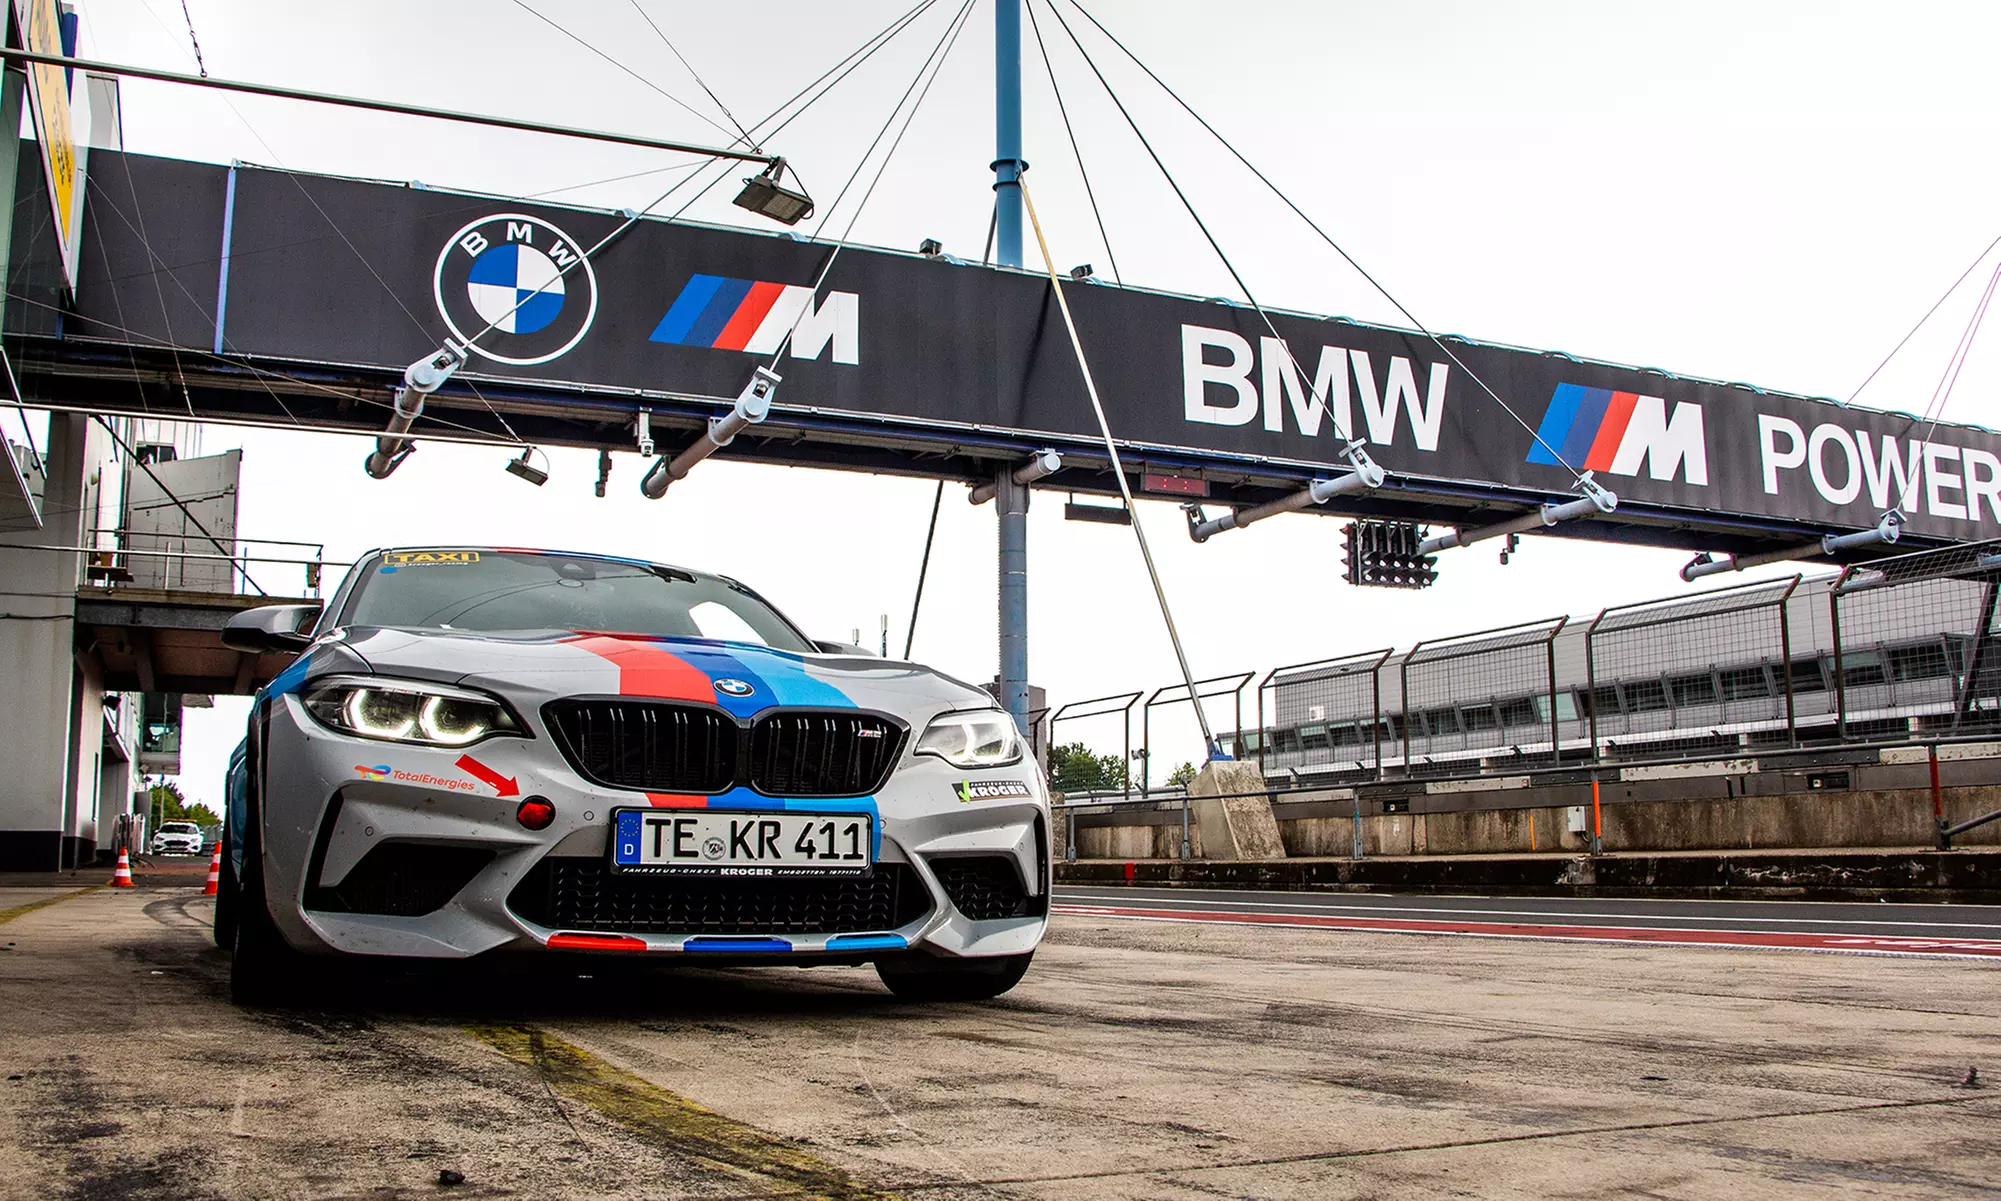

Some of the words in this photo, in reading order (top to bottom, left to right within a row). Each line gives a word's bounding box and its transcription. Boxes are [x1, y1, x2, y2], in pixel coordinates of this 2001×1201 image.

[459, 221, 578, 268] BMW
[1181, 324, 1450, 452] BMW
[1758, 413, 2001, 525] POWER
[393, 552, 470, 563] TAXI
[393, 770, 476, 792] TotalEnergies
[624, 843, 635, 856] D
[645, 818, 699, 858] TE
[730, 820, 782, 859] KR
[795, 821, 864, 860] 411
